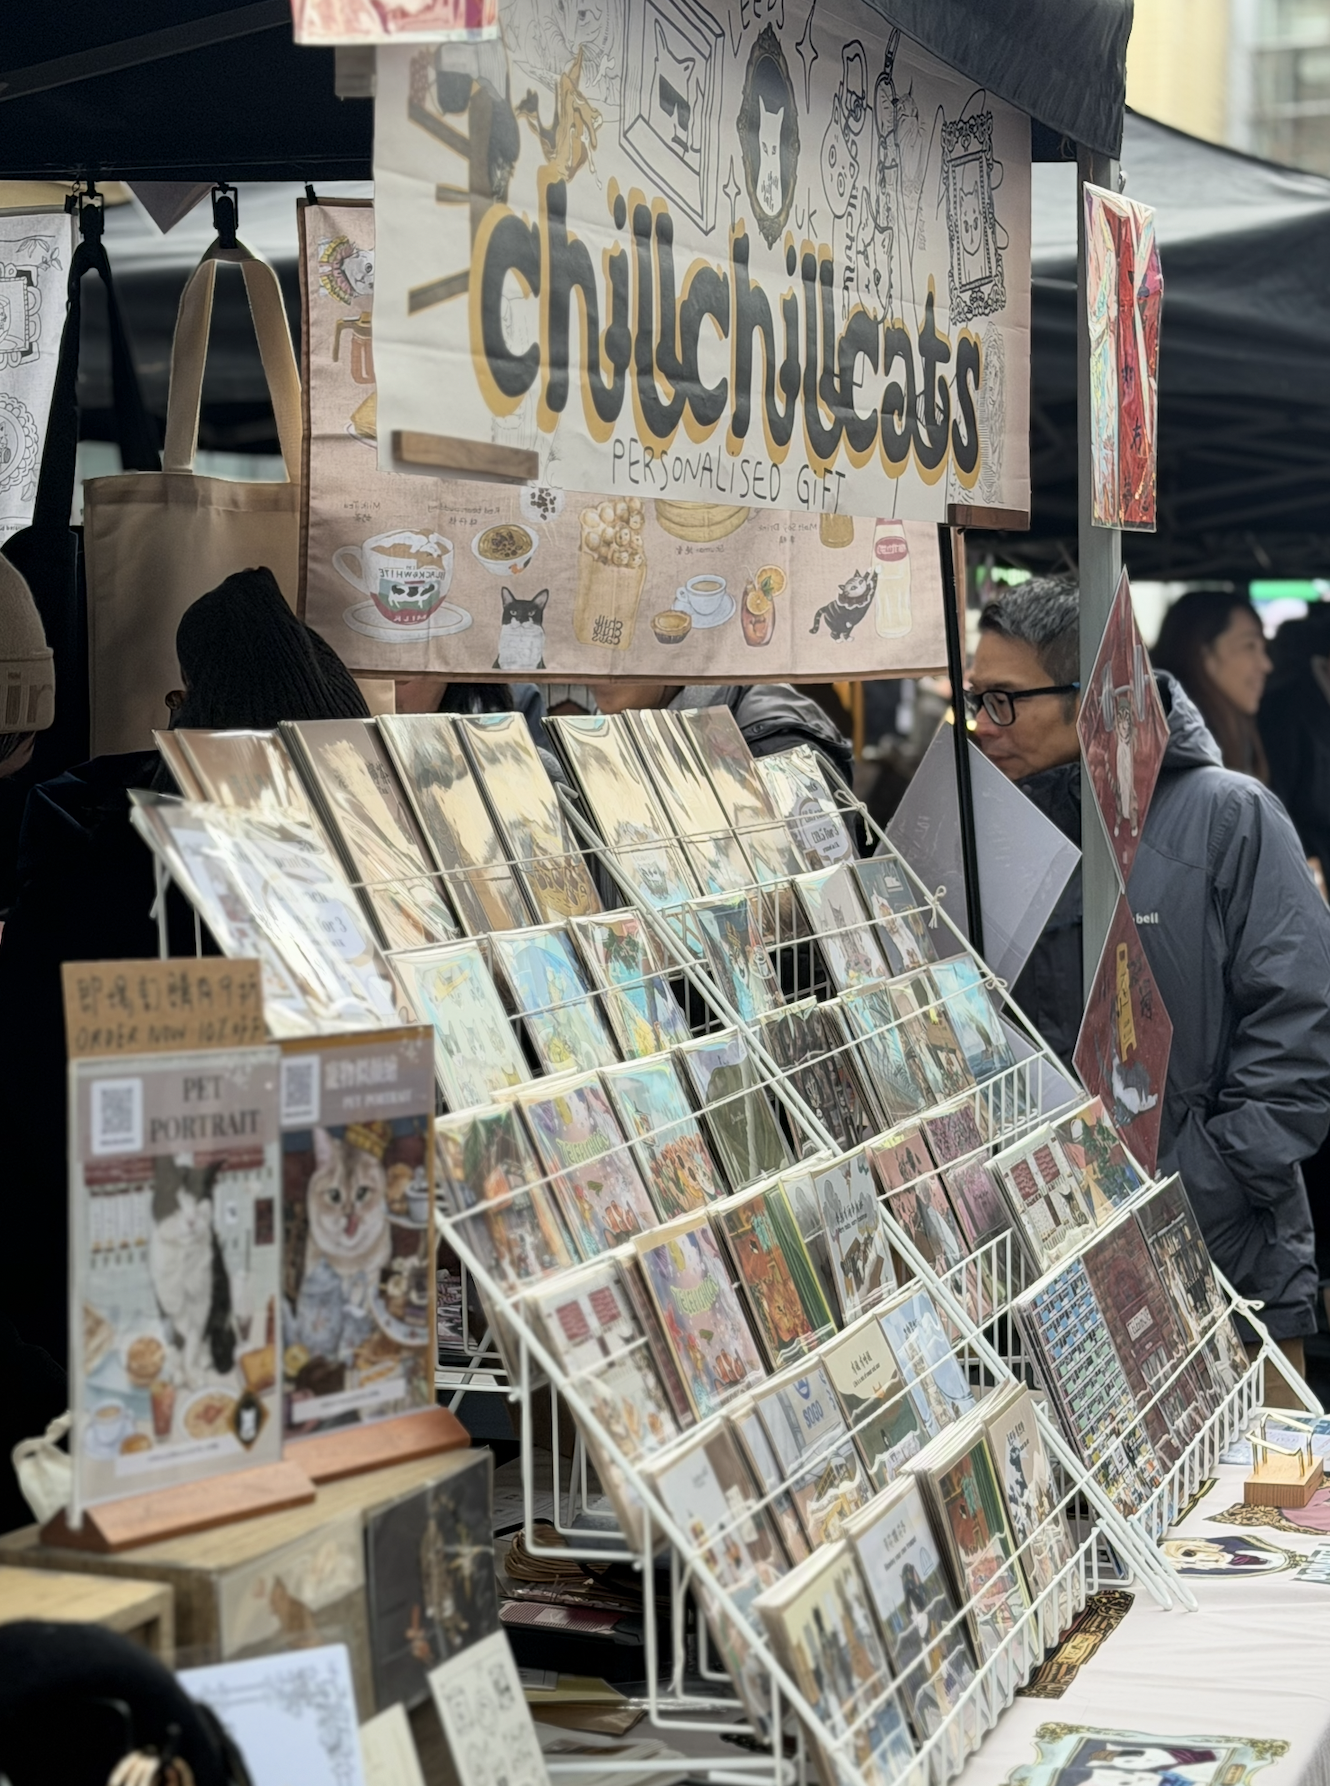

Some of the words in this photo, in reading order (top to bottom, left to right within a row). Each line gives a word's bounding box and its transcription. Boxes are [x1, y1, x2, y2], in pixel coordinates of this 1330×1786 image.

[336, 915, 348, 934] 3
[182, 1075, 224, 1103] PET
[150, 1108, 261, 1143] PORTRAIT
[802, 1400, 825, 1430] SOGO
